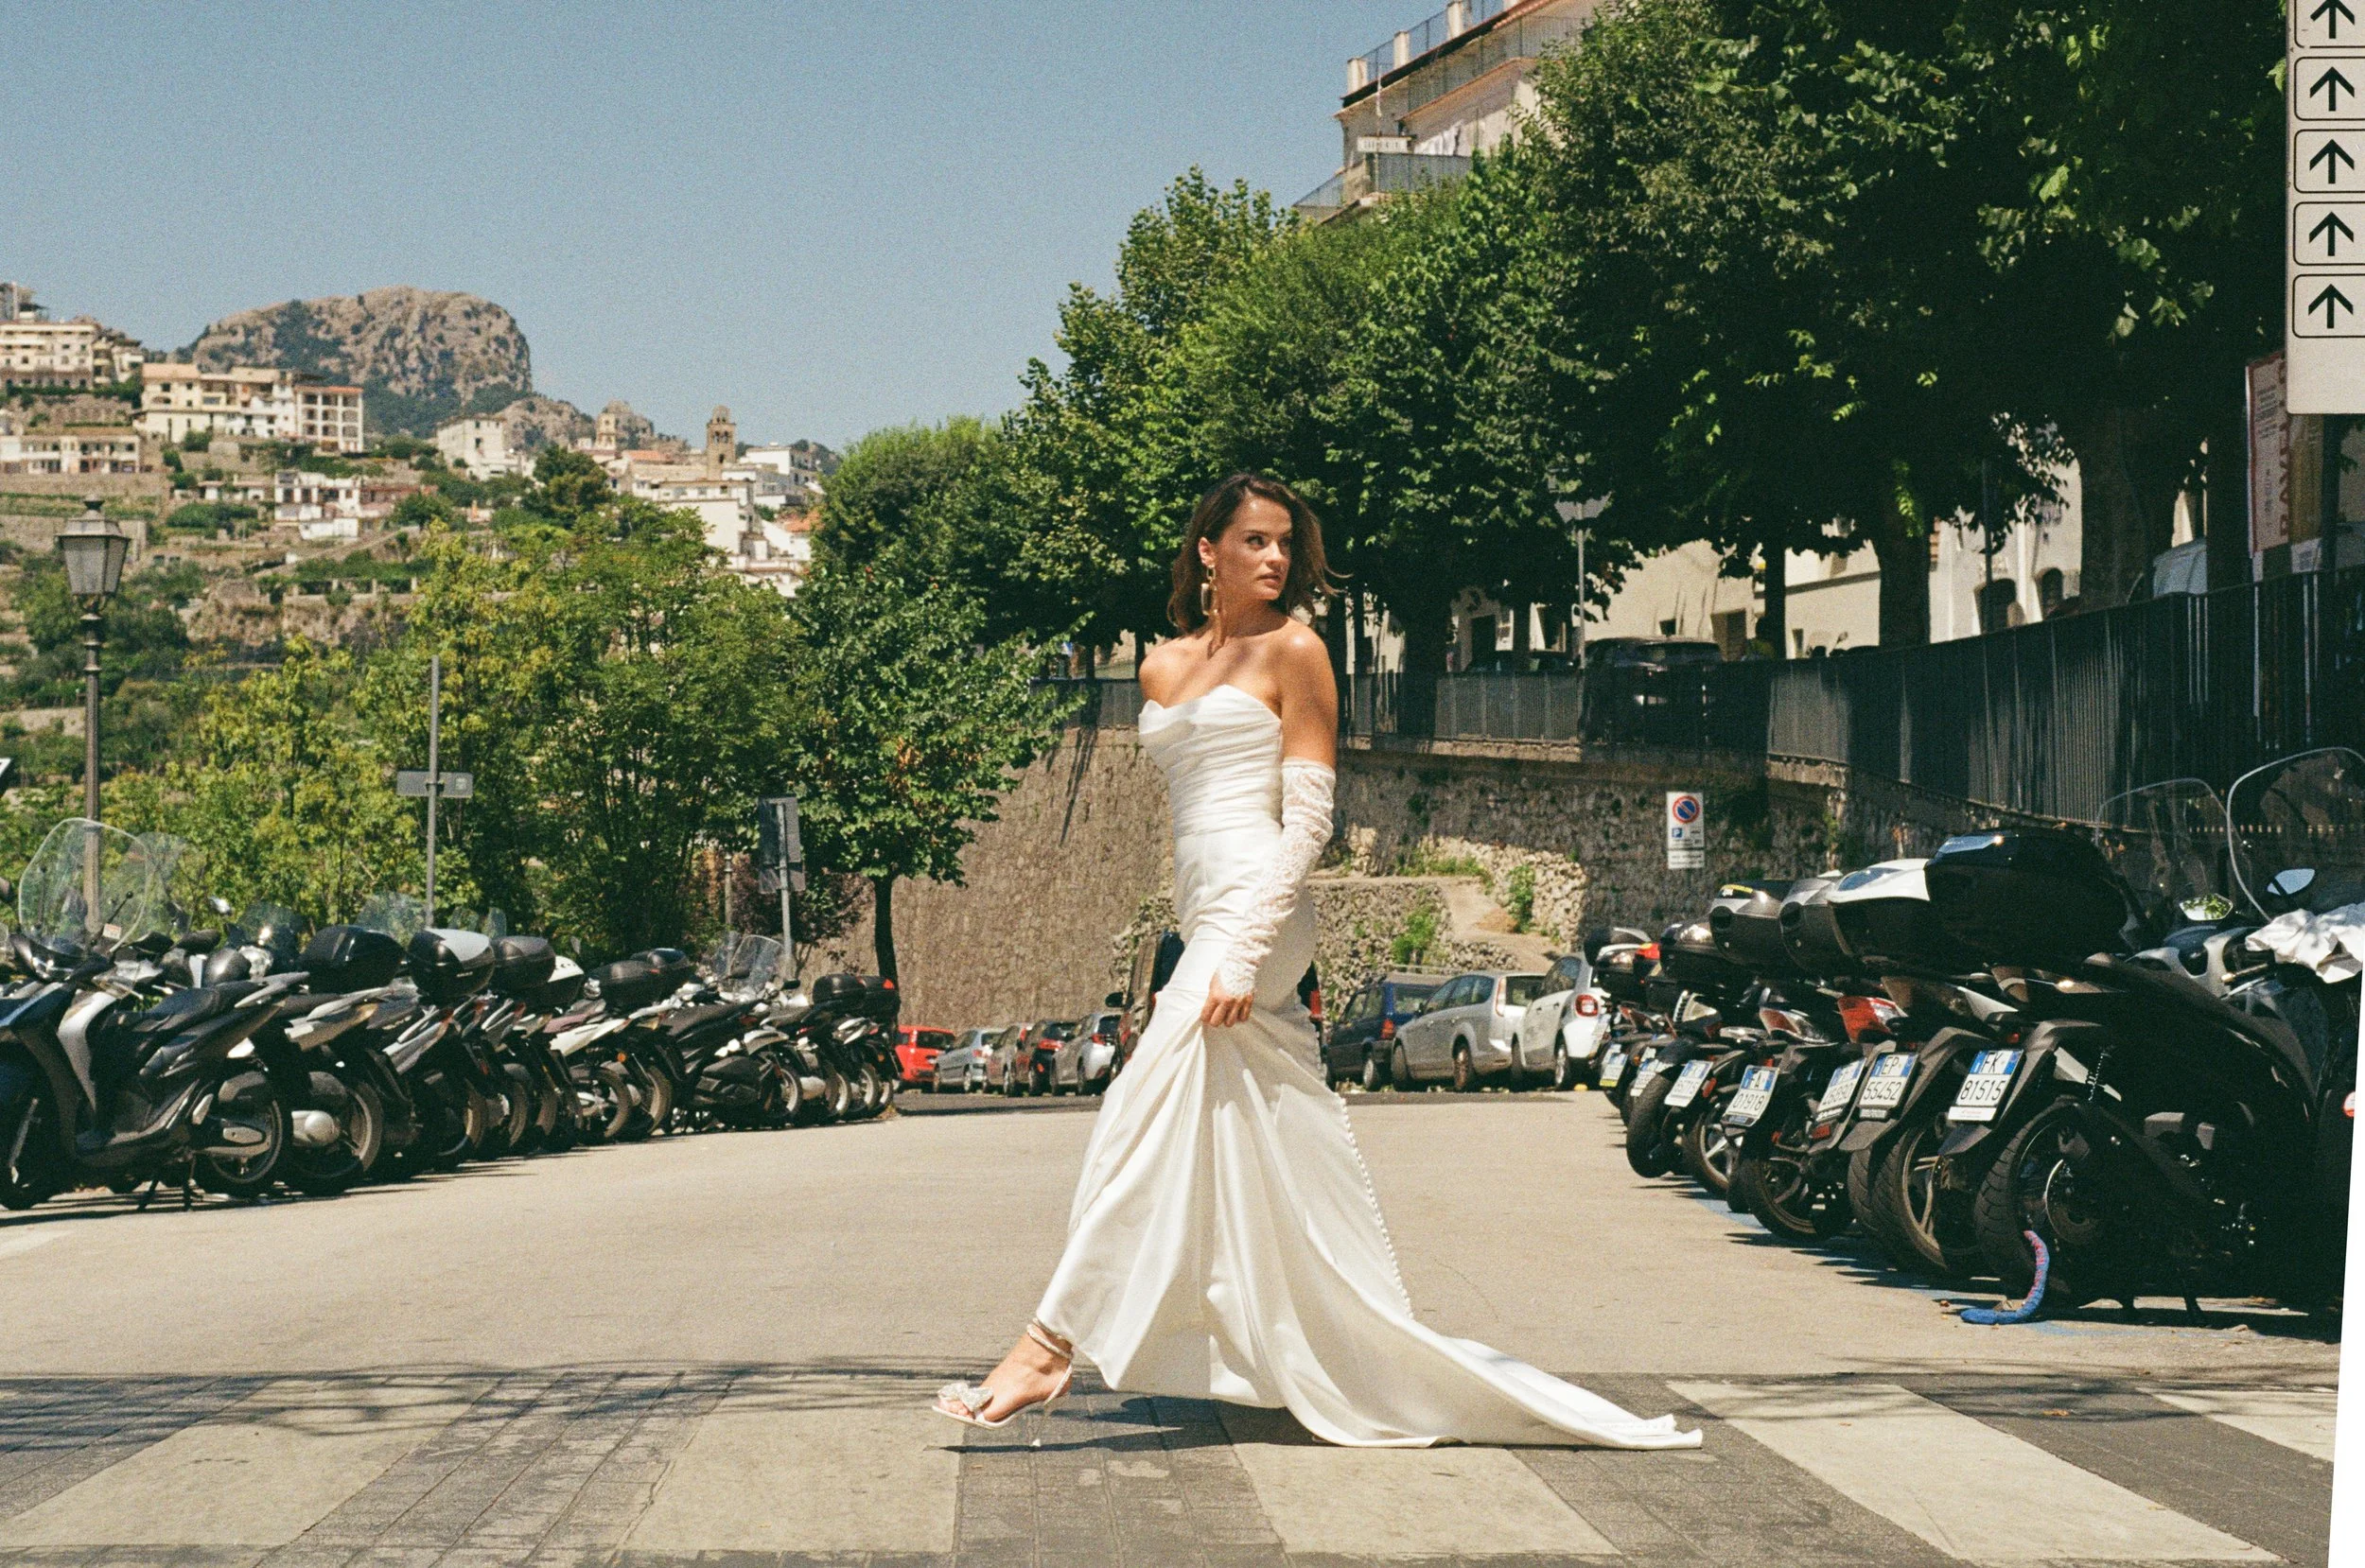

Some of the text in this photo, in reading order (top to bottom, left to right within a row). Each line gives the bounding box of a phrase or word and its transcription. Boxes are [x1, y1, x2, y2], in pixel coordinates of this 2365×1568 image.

[1882, 1056, 1900, 1075] EP
[1981, 1051, 2004, 1073] FK
[1864, 1081, 1902, 1101] 55452
[1960, 1079, 2006, 1101] 81515
[1732, 1093, 1765, 1111] 01918
